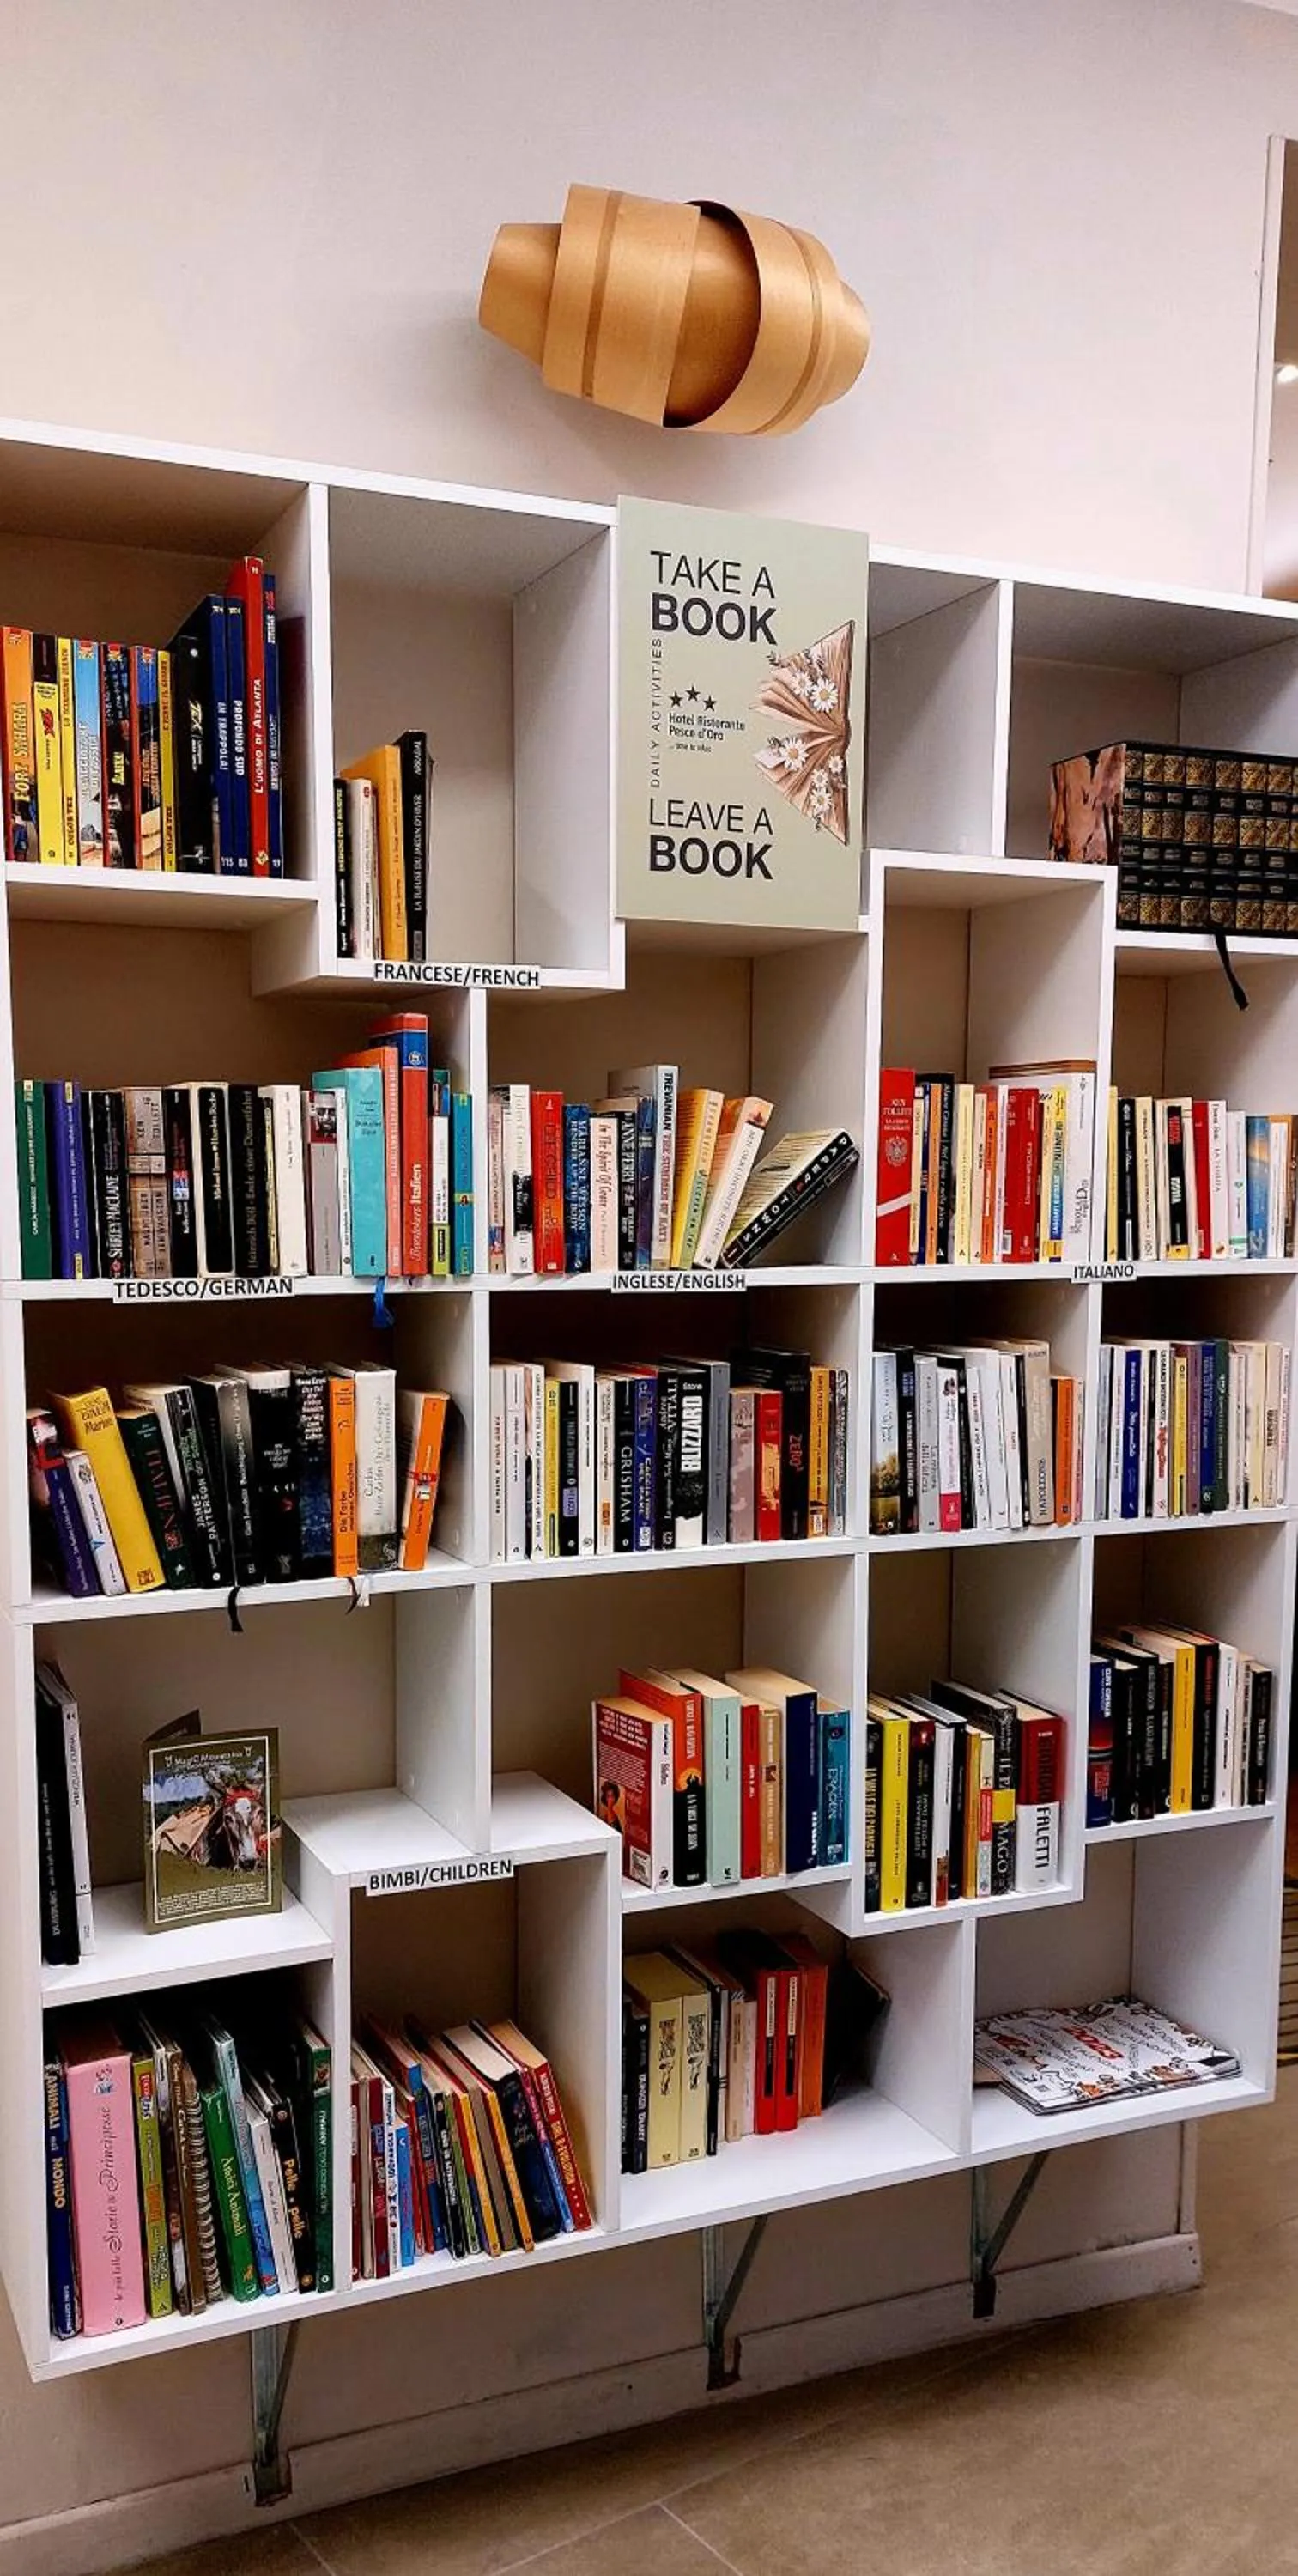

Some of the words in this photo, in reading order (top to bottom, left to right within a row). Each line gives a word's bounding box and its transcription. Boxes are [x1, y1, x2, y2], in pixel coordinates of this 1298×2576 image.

[650, 550, 742, 594] TAKE
[751, 566, 775, 598] A
[652, 592, 779, 646] BOOK
[652, 637, 664, 732] ACTIVITIES
[234, 700, 245, 754] PROFONDO
[669, 712, 694, 726] Hotel
[697, 715, 746, 731] Ristorante
[669, 726, 695, 738] Pesce
[698, 728, 725, 741] d'Oro
[234, 756, 246, 776] SUD
[651, 739, 660, 788] DAILY
[650, 798, 744, 834] LEAVE
[753, 807, 774, 835] A
[649, 835, 774, 880] BOOK
[374, 963, 539, 987] FRANCESE/FRENCH
[663, 1072, 674, 1131] TREVANIAN
[578, 1121, 587, 1181] MARIANNE
[621, 1121, 634, 1151] ANNE
[409, 1164, 422, 1205] Italien
[621, 1151, 634, 1183] PERRY
[578, 1185, 586, 1230] WESSON
[113, 1279, 293, 1298] TEDESCO/GERMAN
[613, 1273, 746, 1292] INGLESE/ENGLISH
[1074, 1265, 1134, 1278] ITALIANO
[620, 1445, 632, 1522] GRISHAM
[191, 1494, 206, 1528] JAMES
[197, 1478, 218, 1540] PATTERSON
[1035, 1807, 1051, 1868] FALETTI
[370, 1859, 513, 1890] BIMBI/CHILDREN
[46, 2073, 62, 2130] ANIMALI
[97, 2105, 118, 2192] Principesse
[52, 2156, 65, 2209] MONDO
[282, 2158, 297, 2192] Pelle
[101, 2205, 123, 2254] Storie
